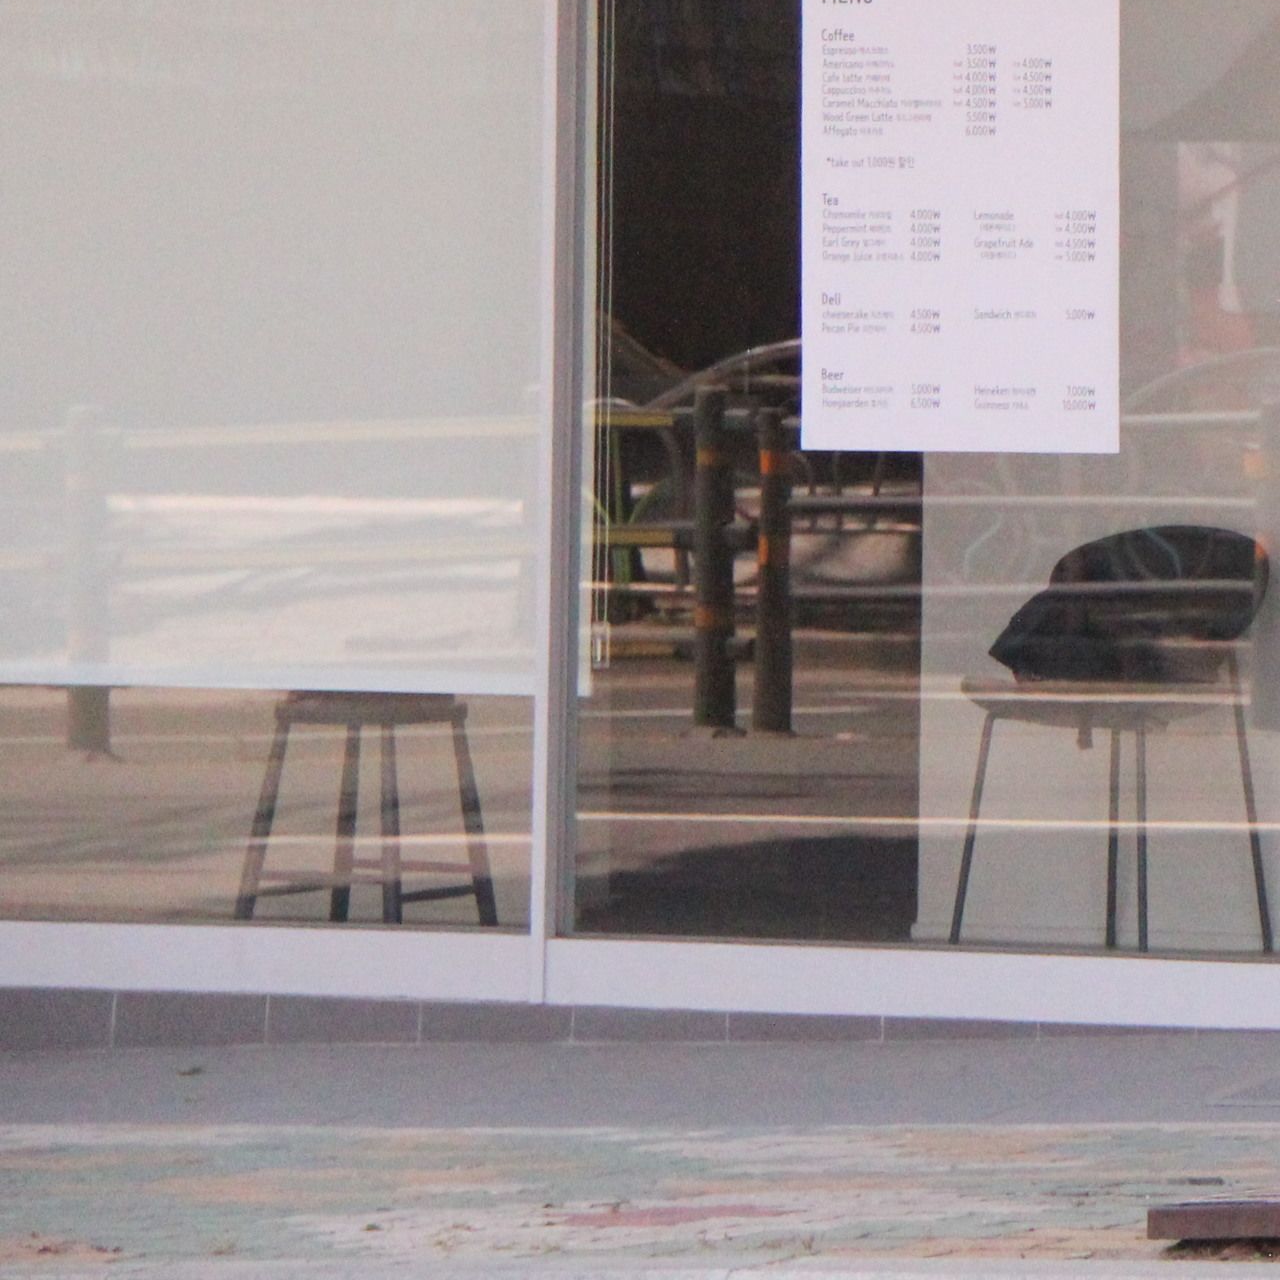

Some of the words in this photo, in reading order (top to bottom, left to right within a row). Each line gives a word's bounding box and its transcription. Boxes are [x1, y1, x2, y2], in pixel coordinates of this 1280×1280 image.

[821, 29, 855, 42] Coffee
[822, 192, 839, 206] Tea
[821, 292, 841, 306] Deli
[821, 367, 844, 380] Beer
